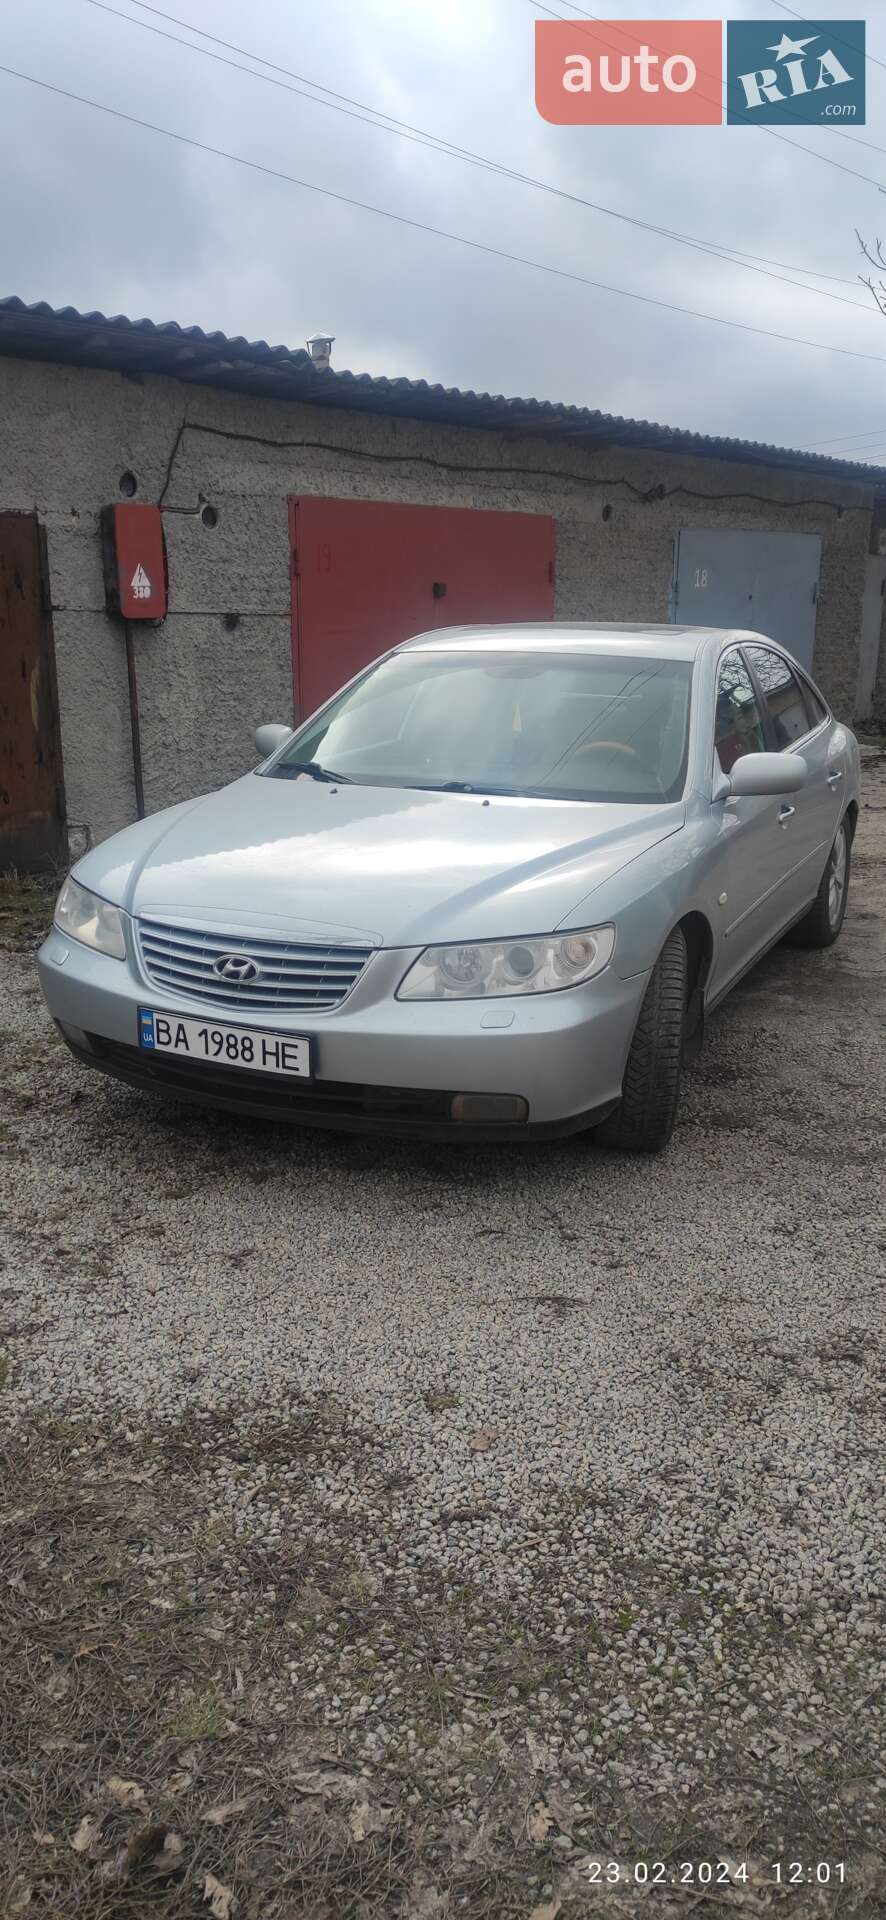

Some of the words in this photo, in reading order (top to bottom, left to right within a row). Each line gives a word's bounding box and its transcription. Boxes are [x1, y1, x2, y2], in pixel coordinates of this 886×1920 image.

[694, 568, 708, 588] 18
[132, 586, 151, 599] 380
[143, 1033, 154, 1044] UA
[155, 1018, 190, 1051] BA
[198, 1028, 255, 1063] 1988
[262, 1039, 300, 1072] HE
